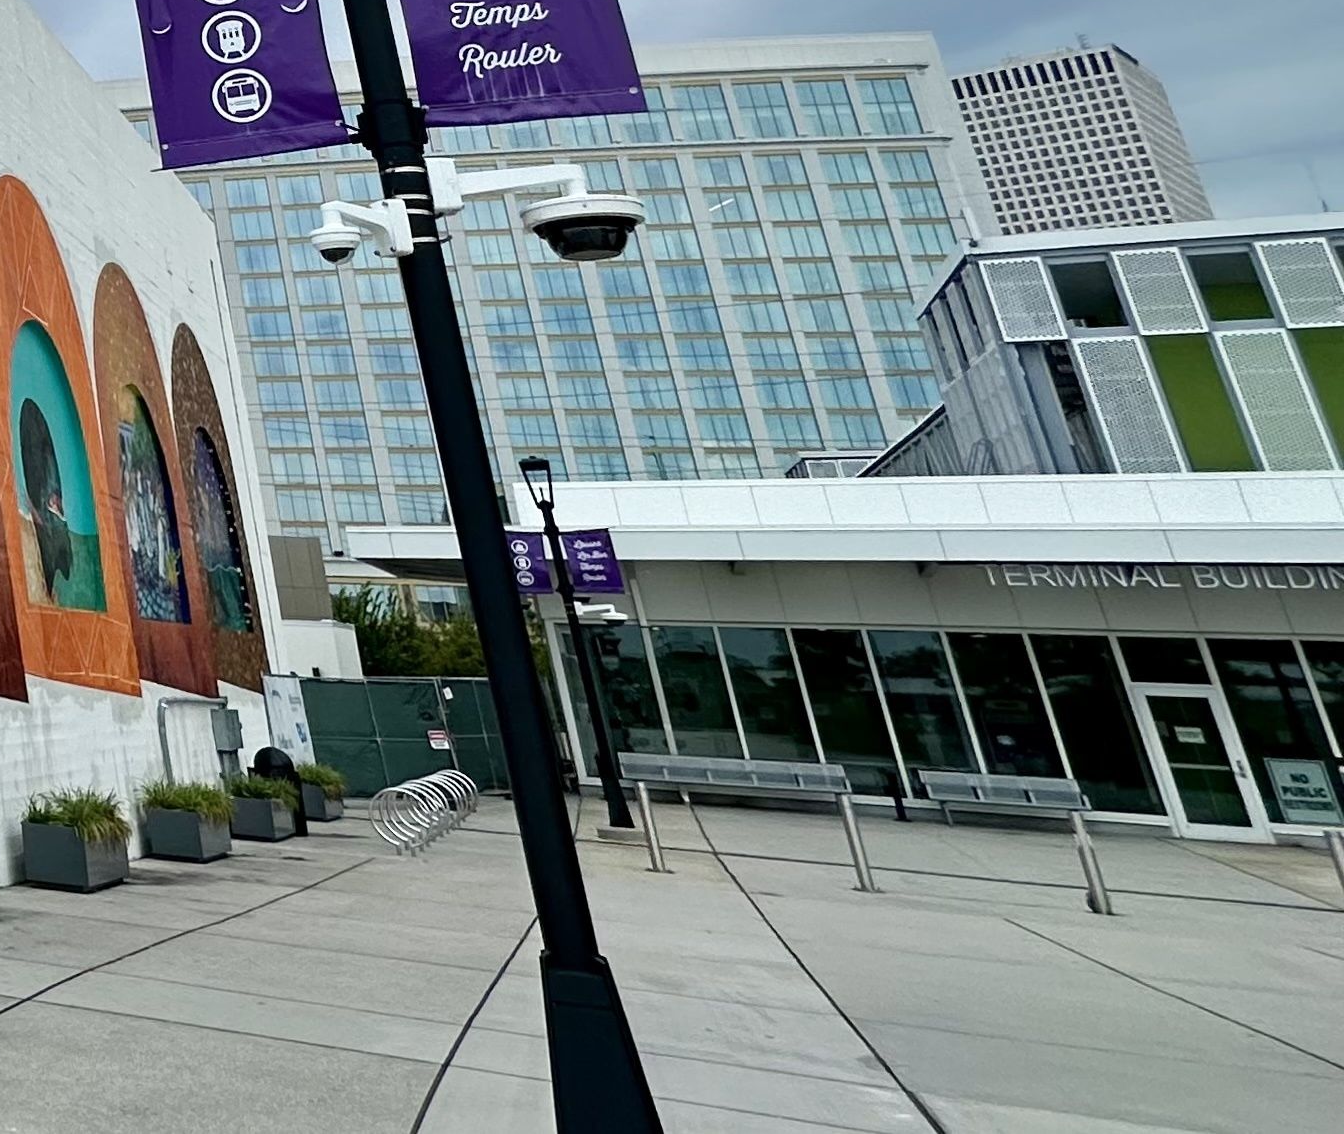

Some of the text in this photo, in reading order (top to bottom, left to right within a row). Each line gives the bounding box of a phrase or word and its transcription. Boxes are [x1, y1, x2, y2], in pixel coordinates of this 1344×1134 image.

[450, 1, 549, 28] Temps
[459, 42, 561, 78] Rouler
[979, 564, 1182, 588] TERMINAL
[1289, 773, 1309, 784] NO
[1280, 785, 1328, 798] PUBLIC
